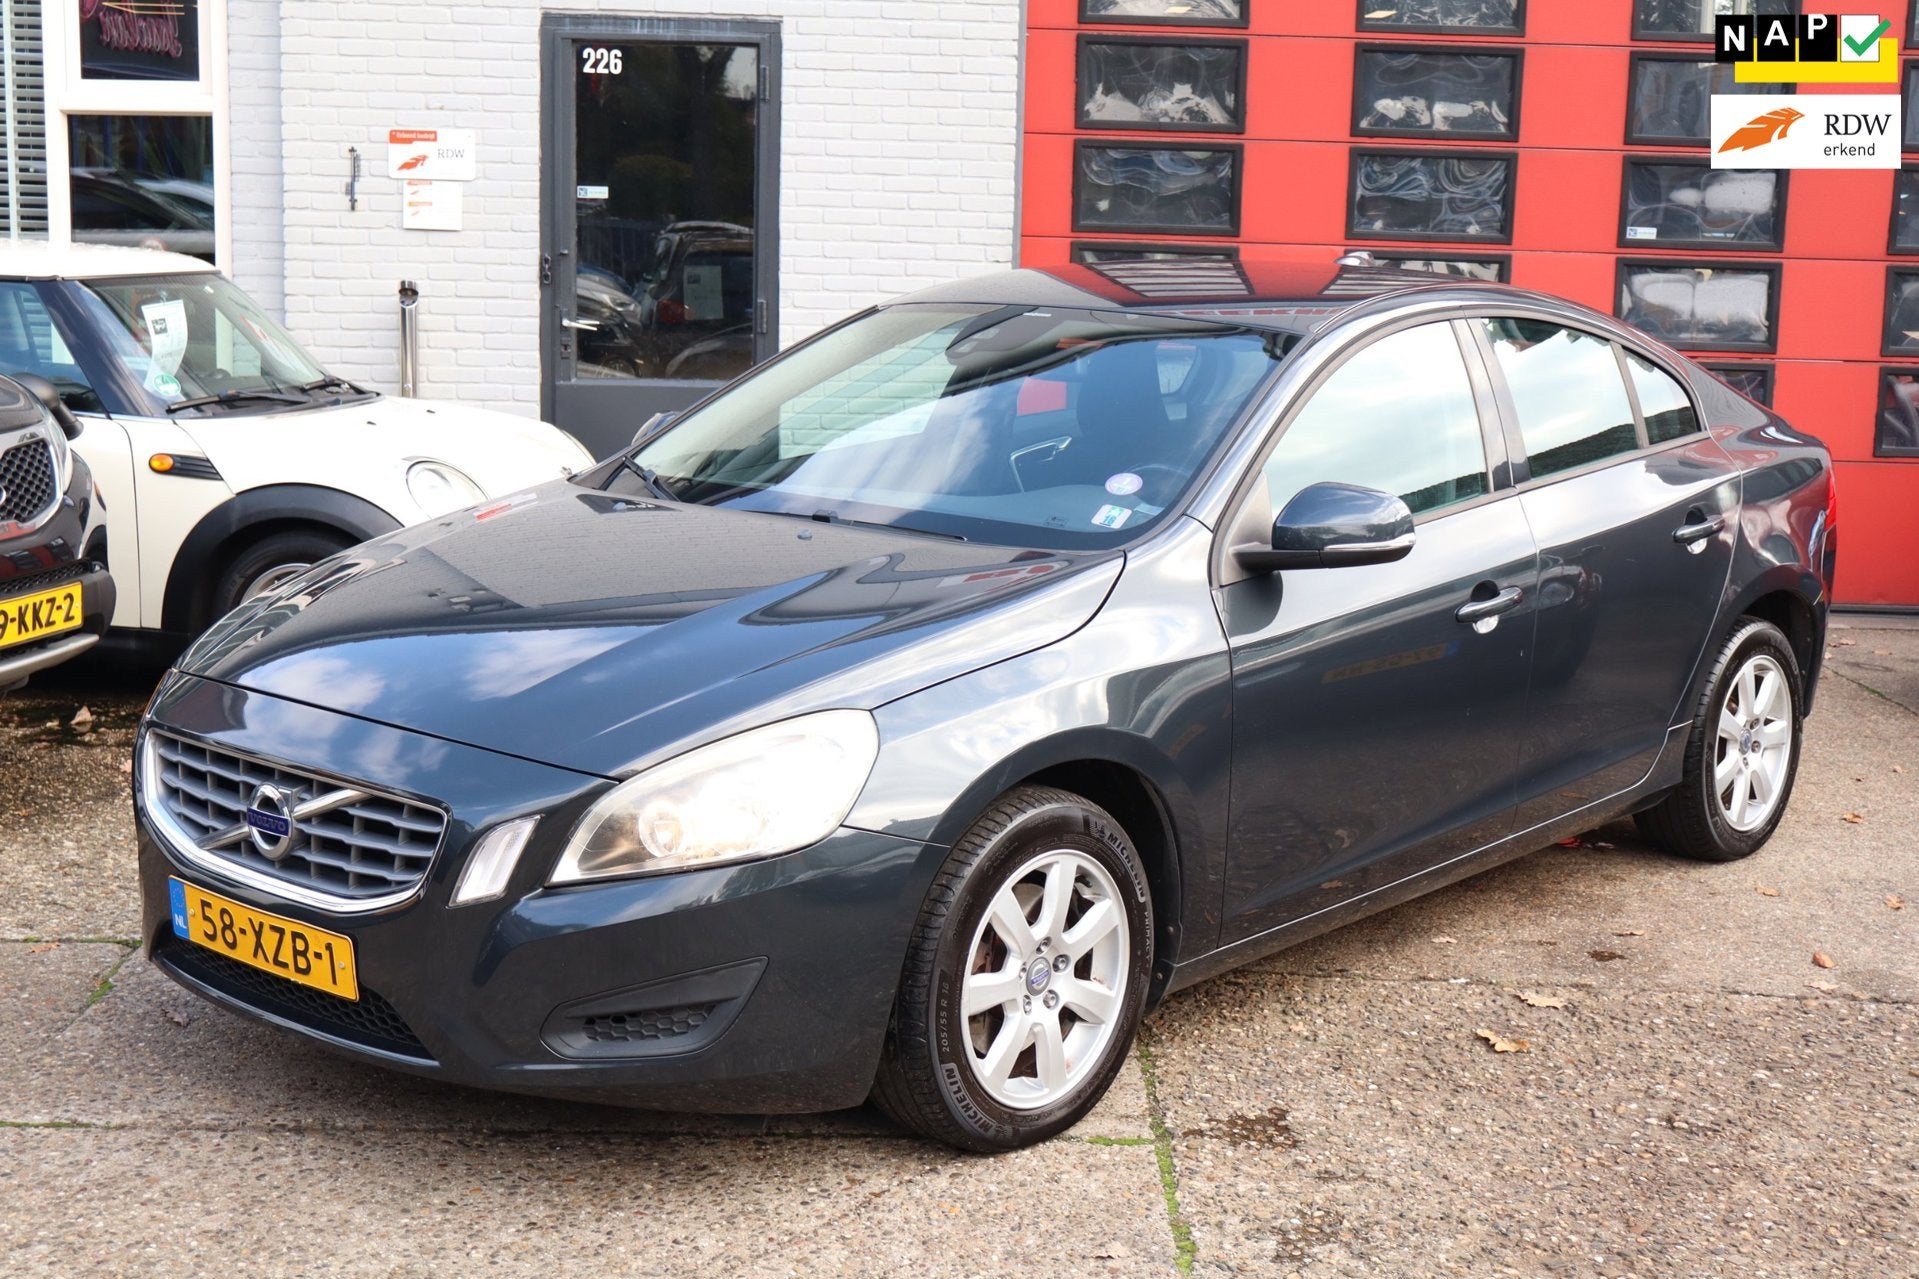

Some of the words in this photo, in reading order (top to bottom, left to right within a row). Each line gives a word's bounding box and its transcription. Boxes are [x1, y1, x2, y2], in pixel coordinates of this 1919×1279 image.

[582, 47, 623, 75] 226
[437, 148, 465, 159] RDW
[0, 592, 75, 640] 9-KKZ-2
[248, 811, 286, 832] VOLVO
[1106, 832, 1146, 899] MICHELIN
[174, 913, 188, 930] NL
[200, 898, 338, 986] 58-XZB-1
[939, 1009, 951, 1053] 205/55
[944, 1067, 994, 1134] MICHELIN
